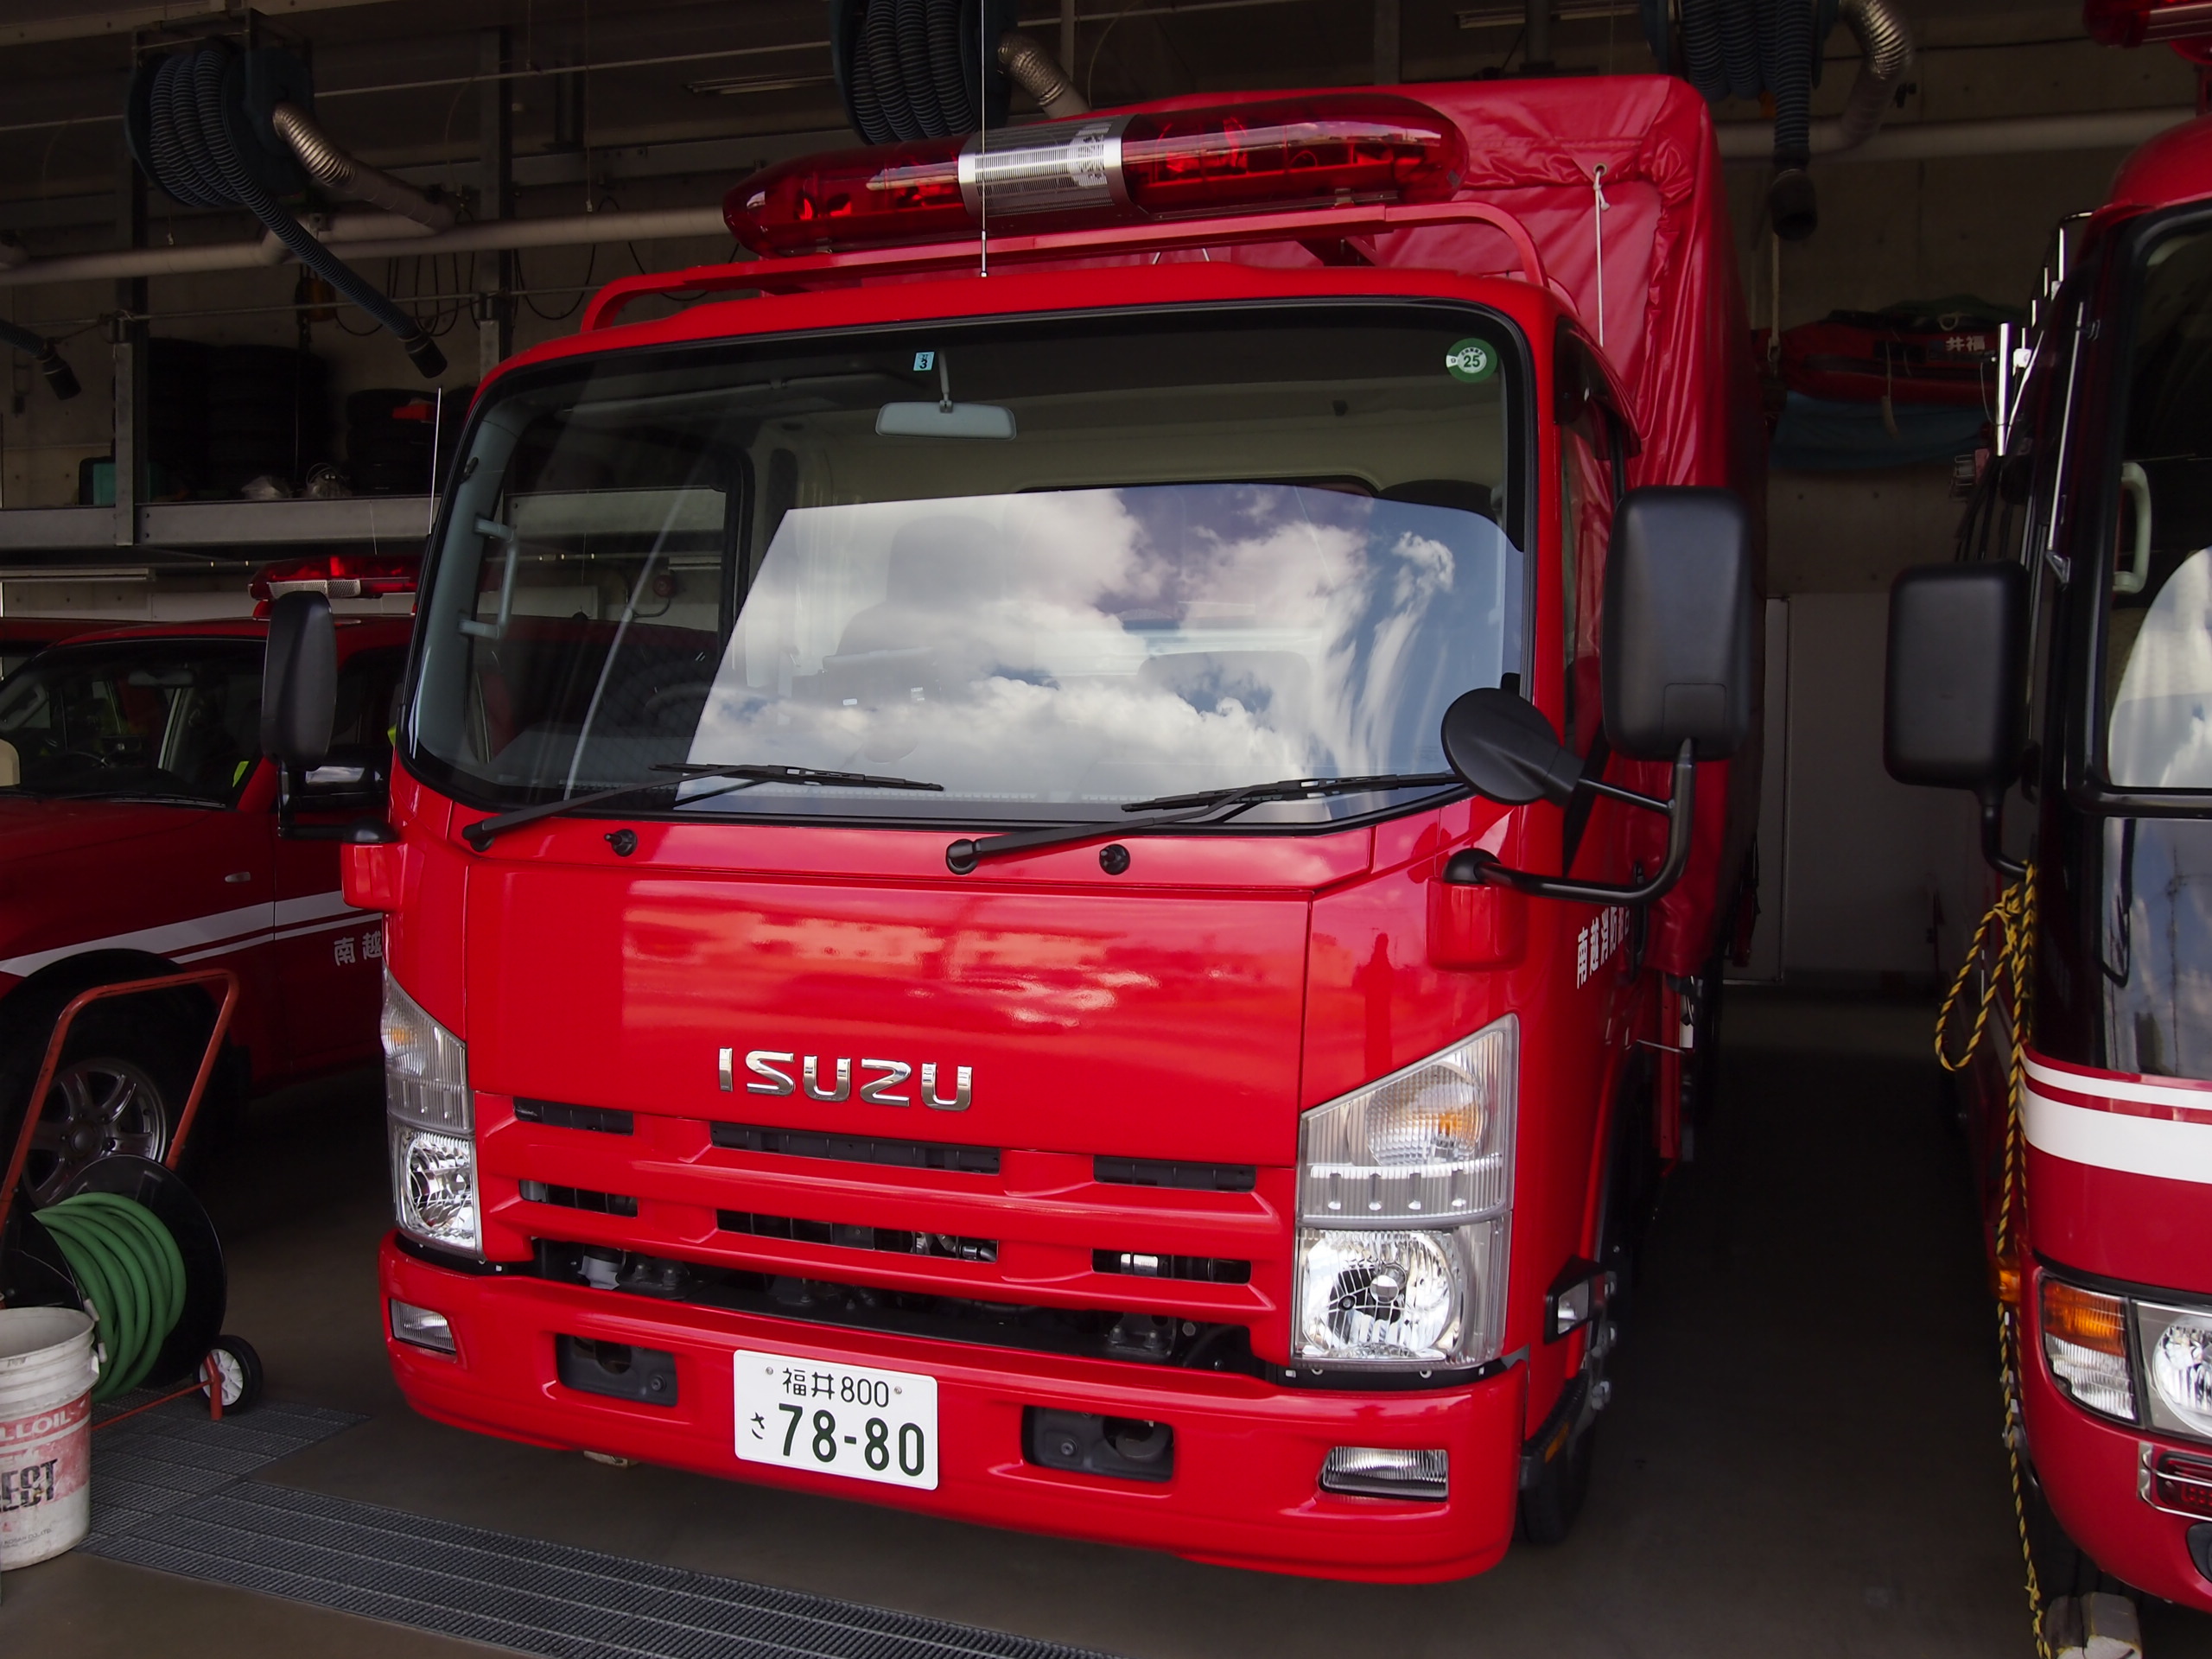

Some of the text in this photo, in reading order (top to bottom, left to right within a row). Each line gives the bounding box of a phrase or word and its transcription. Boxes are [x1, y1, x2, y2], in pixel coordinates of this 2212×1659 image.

[1463, 354, 1480, 368] 25
[719, 1047, 973, 1111] ISUZU
[750, 1403, 925, 1477] さ 78-80
[0, 1459, 58, 1513] EST
